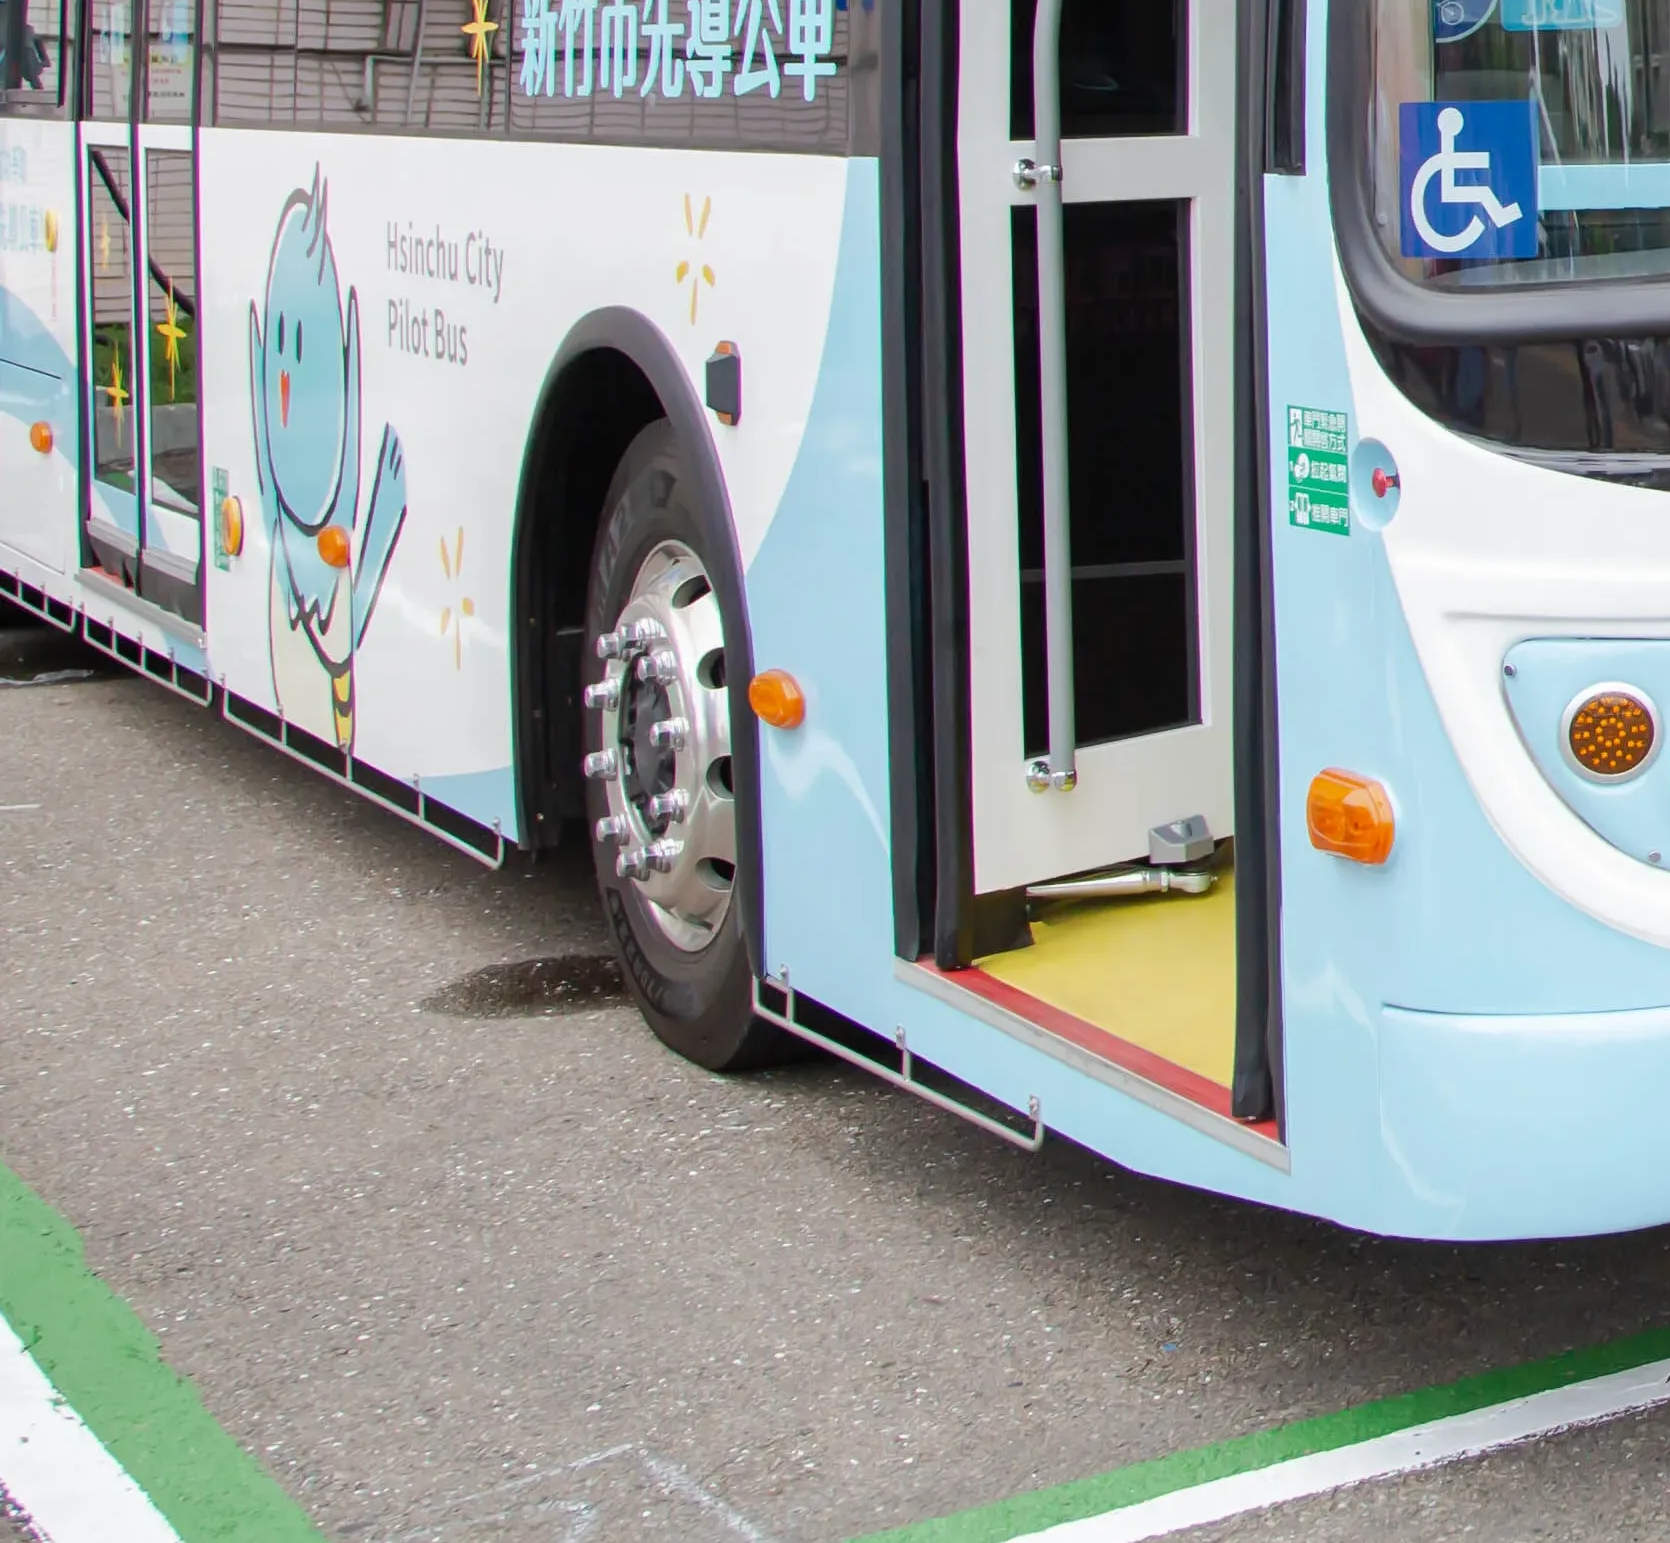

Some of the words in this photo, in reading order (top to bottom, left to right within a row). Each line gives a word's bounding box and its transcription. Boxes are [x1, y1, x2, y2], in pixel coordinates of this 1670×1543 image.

[387, 221, 458, 282] Hsinchu
[465, 229, 503, 304] City
[388, 298, 429, 358] Pilot
[434, 309, 468, 366] Bus
